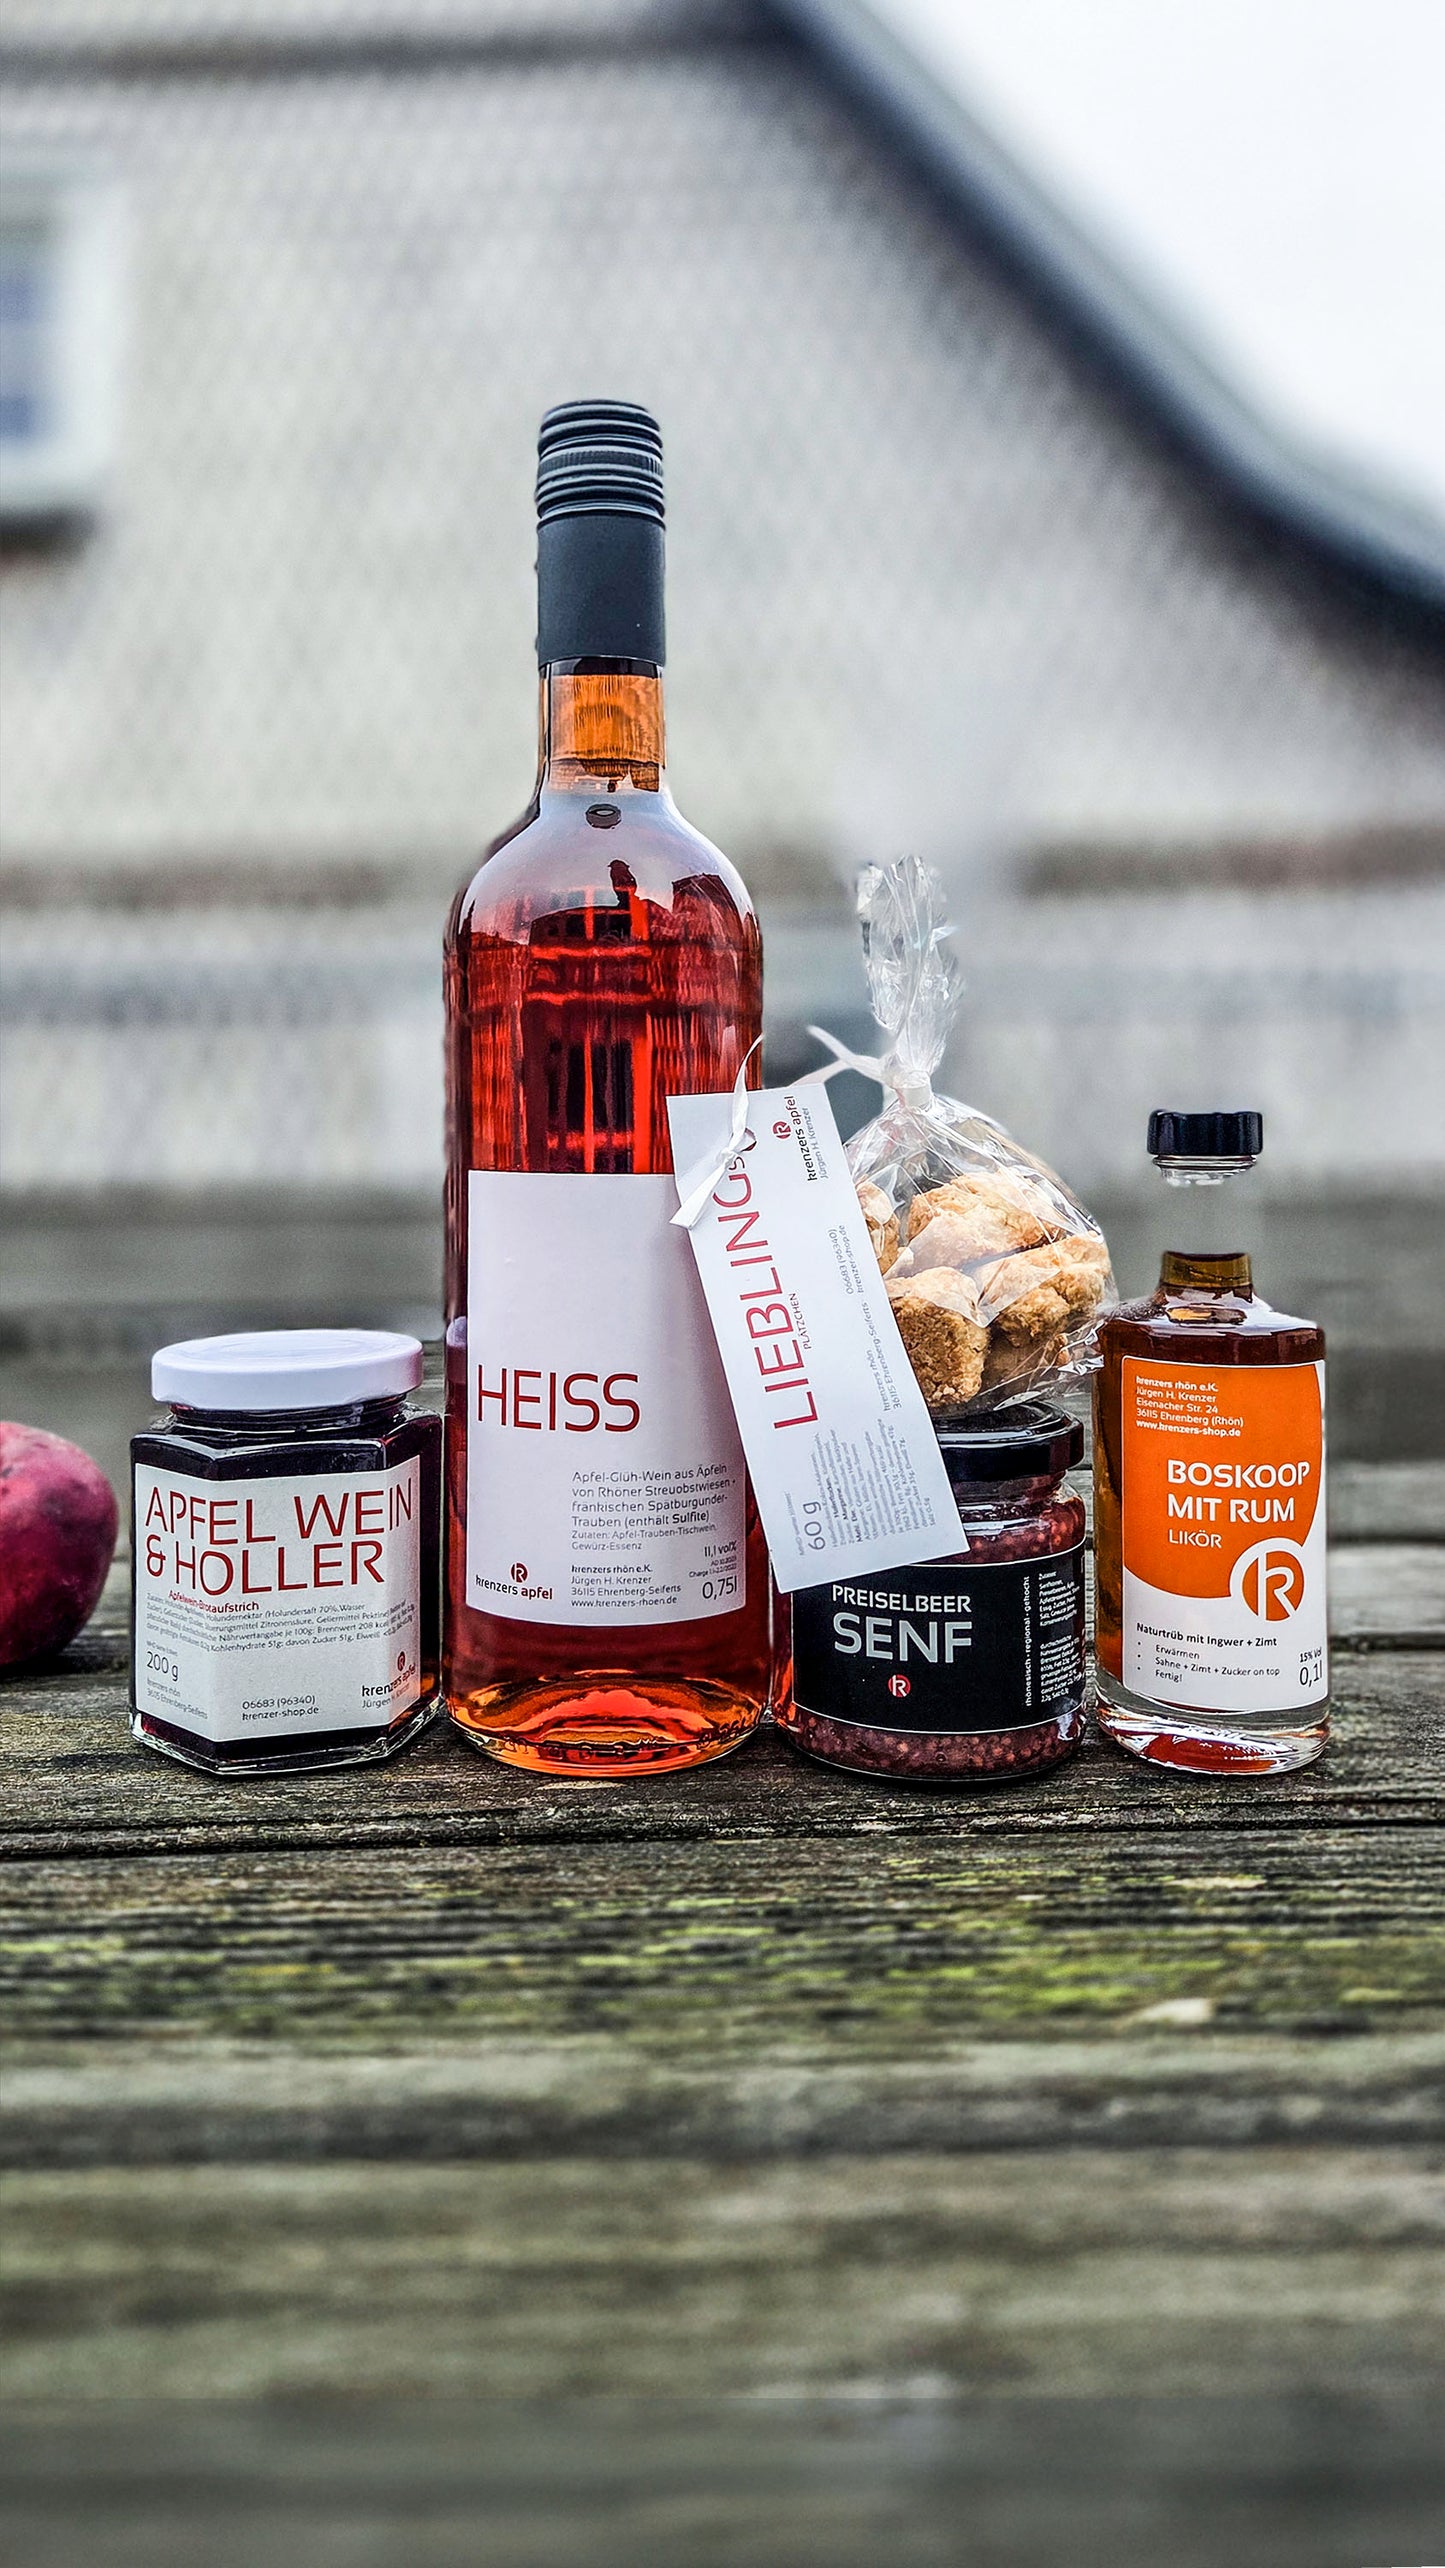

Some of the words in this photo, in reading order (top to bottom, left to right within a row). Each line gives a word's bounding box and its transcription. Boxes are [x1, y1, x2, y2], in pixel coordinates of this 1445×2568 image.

[784, 1095, 800, 1125] apfel
[789, 1292, 811, 1349] PLÄTZCHEN
[1175, 1381, 1197, 1390] rhön
[478, 1364, 641, 1432] HEISS
[1136, 1397, 1183, 1411] Eisenacher
[1186, 1403, 1202, 1412] Str.
[1205, 1405, 1218, 1414] 24
[1178, 1392, 1216, 1403] Krenzer
[1160, 1411, 1209, 1426] Ehrenberg
[1211, 1416, 1244, 1428] (Rhön)
[675, 1470, 694, 1480] aus
[1167, 1459, 1310, 1488] BOSKOOP
[572, 1488, 594, 1498] von
[598, 1486, 643, 1498] Rhöner
[645, 1479, 730, 1497] Streuobstwiesen
[145, 1487, 276, 1545] APFEL
[294, 1478, 412, 1539] WEIN
[803, 1500, 821, 1515] g
[1167, 1494, 1222, 1522] MIT
[1230, 1497, 1295, 1523] RUM
[572, 1516, 621, 1527] Trauben
[672, 1510, 710, 1524] Sulfite)
[804, 1519, 826, 1551] 60
[1168, 1529, 1222, 1549] LIKÖR
[146, 1534, 166, 1577] &
[176, 1540, 385, 1596] HOLLER
[571, 1576, 601, 1586] Jürgen
[616, 1576, 651, 1585] Krenzer
[598, 1584, 681, 1597] Ehrenberg-Seiferts
[521, 1586, 553, 1600] apfel
[832, 1584, 972, 1613] PREISELBEER
[833, 1612, 972, 1663] SENF
[1136, 1623, 1184, 1642] Naturtrüb
[1186, 1634, 1204, 1644] mit
[1207, 1636, 1244, 1648] Ingwer
[1255, 1637, 1277, 1647] Zimt
[1155, 1644, 1200, 1660] Erwärmen
[147, 1651, 169, 1674] 200
[171, 1664, 179, 1682] g
[1155, 1657, 1181, 1670] Sahne
[1191, 1664, 1211, 1674] Zimt
[1221, 1667, 1250, 1676] Zucker
[1266, 1668, 1280, 1677] top
[242, 1698, 275, 1709] 06683
[277, 1695, 315, 1708] (96340)
